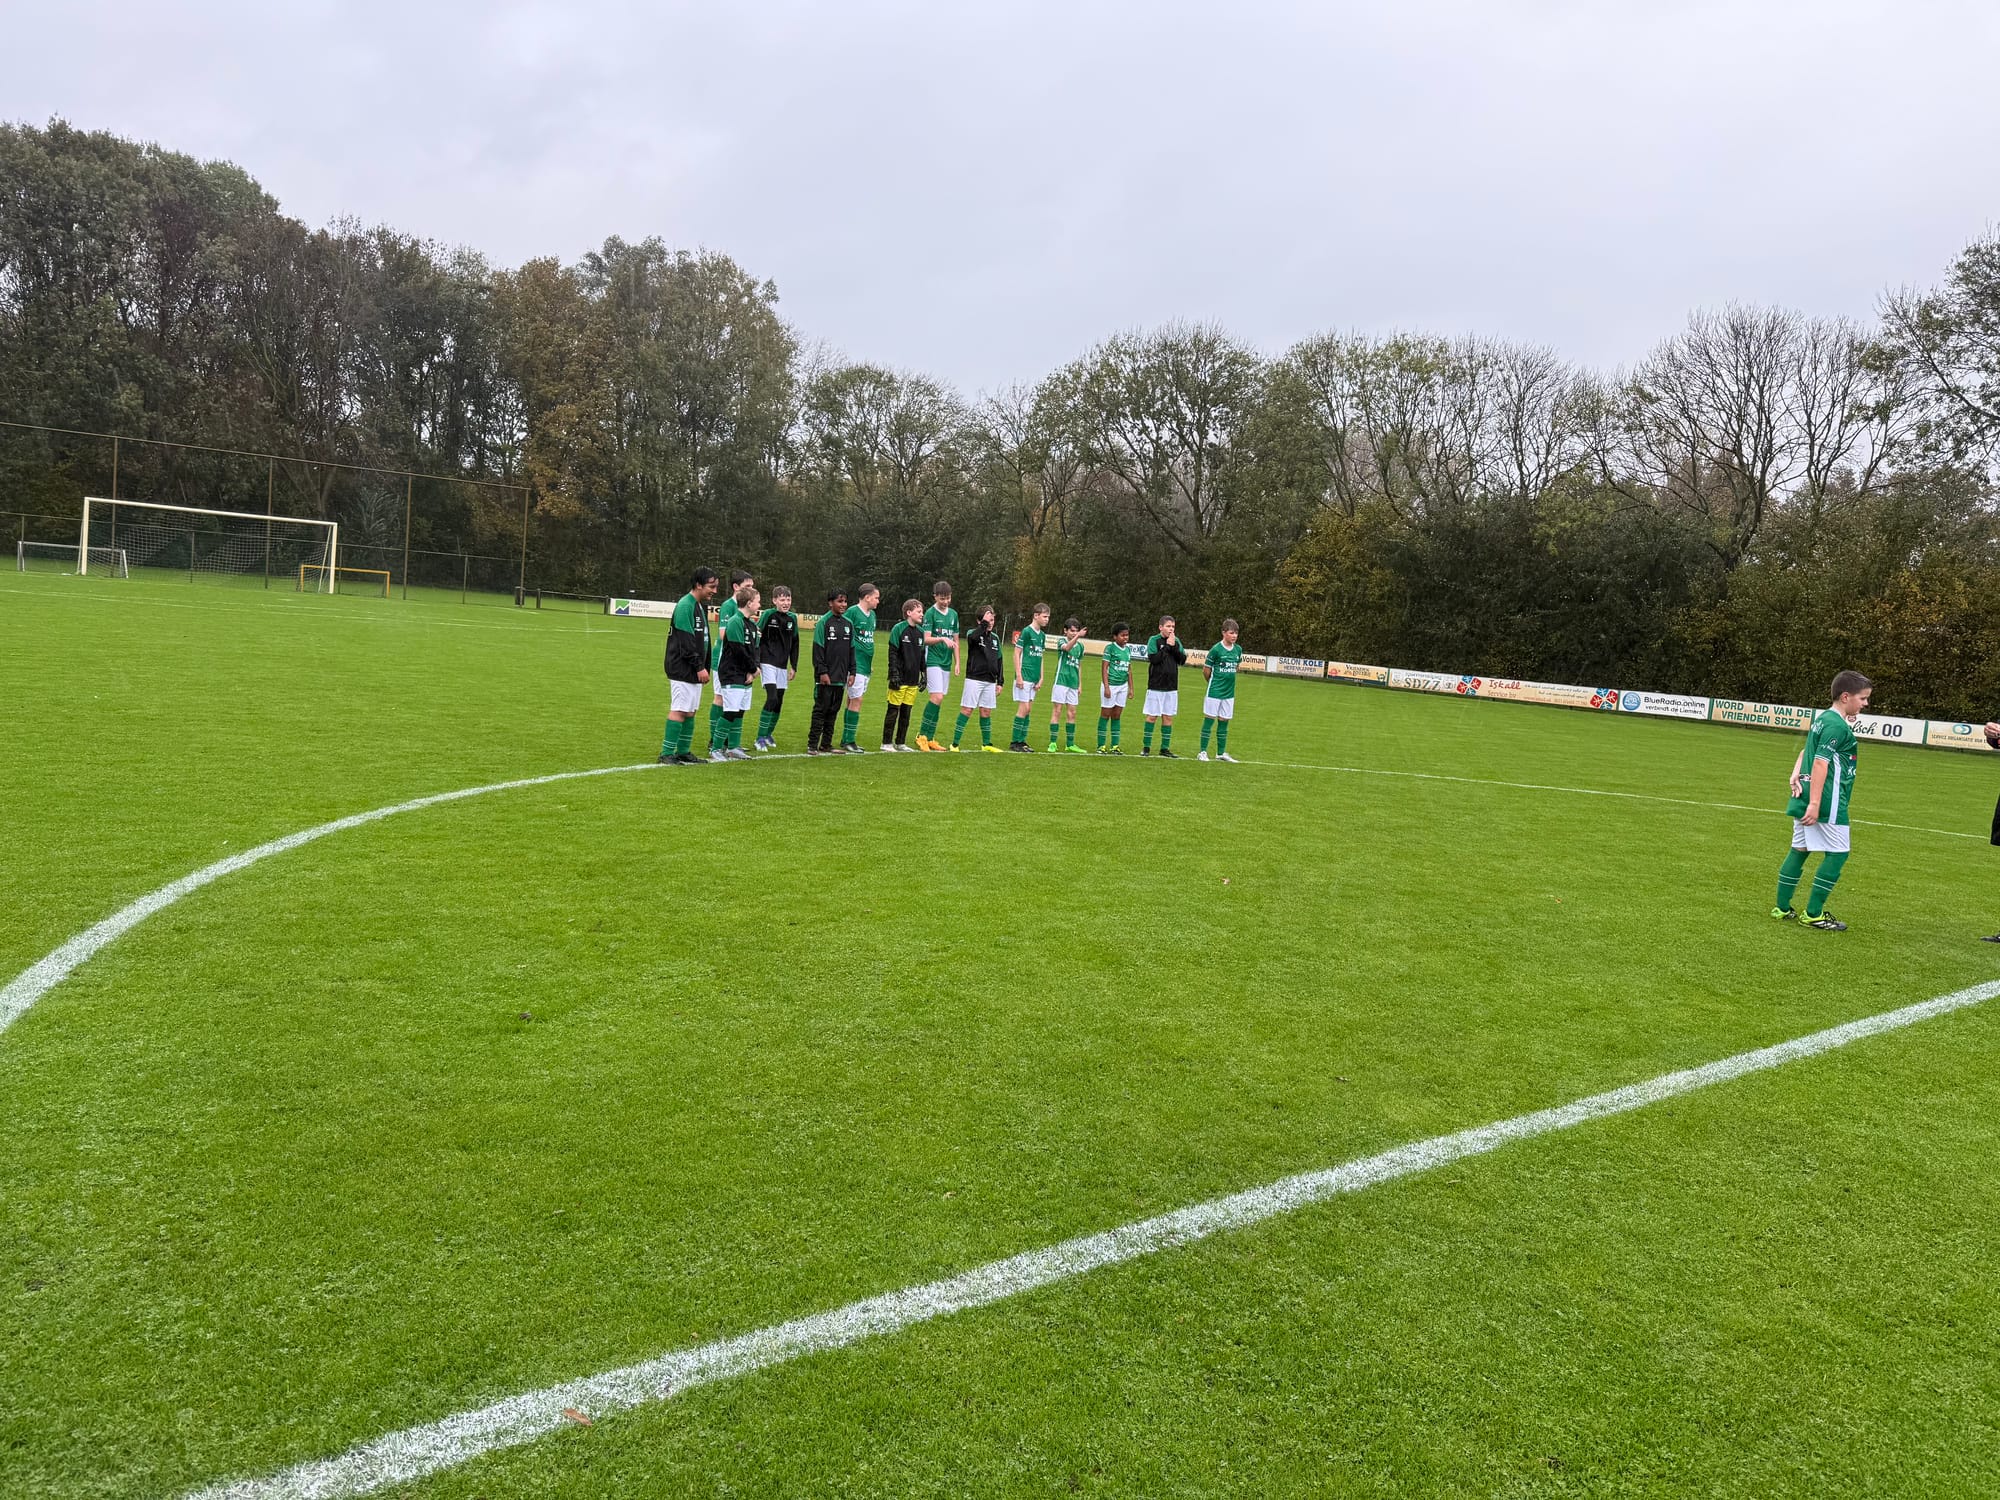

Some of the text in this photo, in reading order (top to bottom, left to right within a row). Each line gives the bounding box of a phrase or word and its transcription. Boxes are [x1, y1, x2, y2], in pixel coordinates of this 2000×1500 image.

[1242, 656, 1266, 664] Volman
[1279, 657, 1323, 667] SALON KOLE
[1404, 677, 1440, 691] SDZZ
[1489, 679, 1521, 690] Iskall
[1644, 696, 1705, 708] BlueRadio.online
[1715, 700, 1811, 718] WORD LID VAN DE
[1721, 710, 1770, 724] VRIENDEN
[1774, 716, 1801, 728] SDZZ
